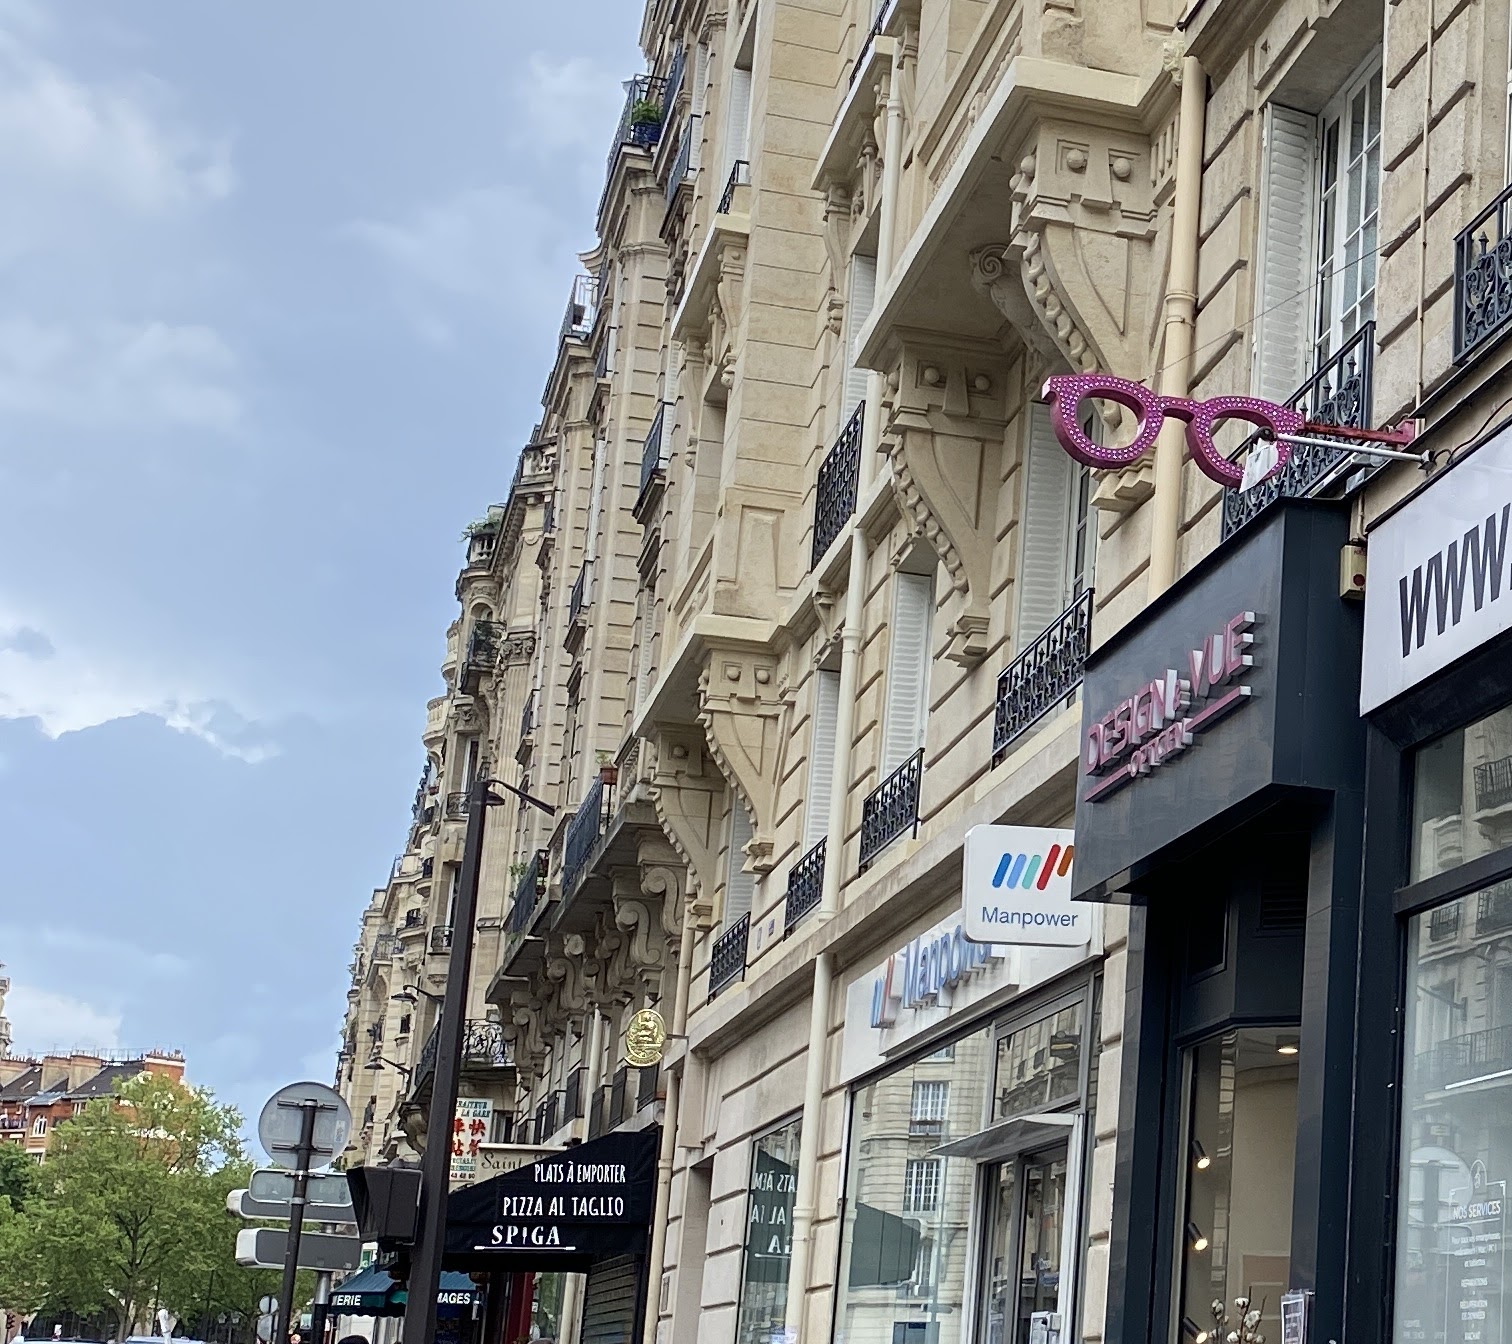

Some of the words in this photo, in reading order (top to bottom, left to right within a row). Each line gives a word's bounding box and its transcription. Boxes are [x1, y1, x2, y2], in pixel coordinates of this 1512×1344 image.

[1086, 669, 1177, 776] DESIGN
[1189, 611, 1255, 698] VUE
[981, 906, 1079, 929] Manpower
[534, 1163, 564, 1183] PLATS
[566, 1160, 574, 1183] À
[576, 1163, 626, 1183] EMPORTER
[502, 1196, 543, 1216] PIZZA
[548, 1196, 566, 1216] AL
[571, 1196, 624, 1216] TAGLIO
[1468, 1200, 1501, 1218] SERVICES
